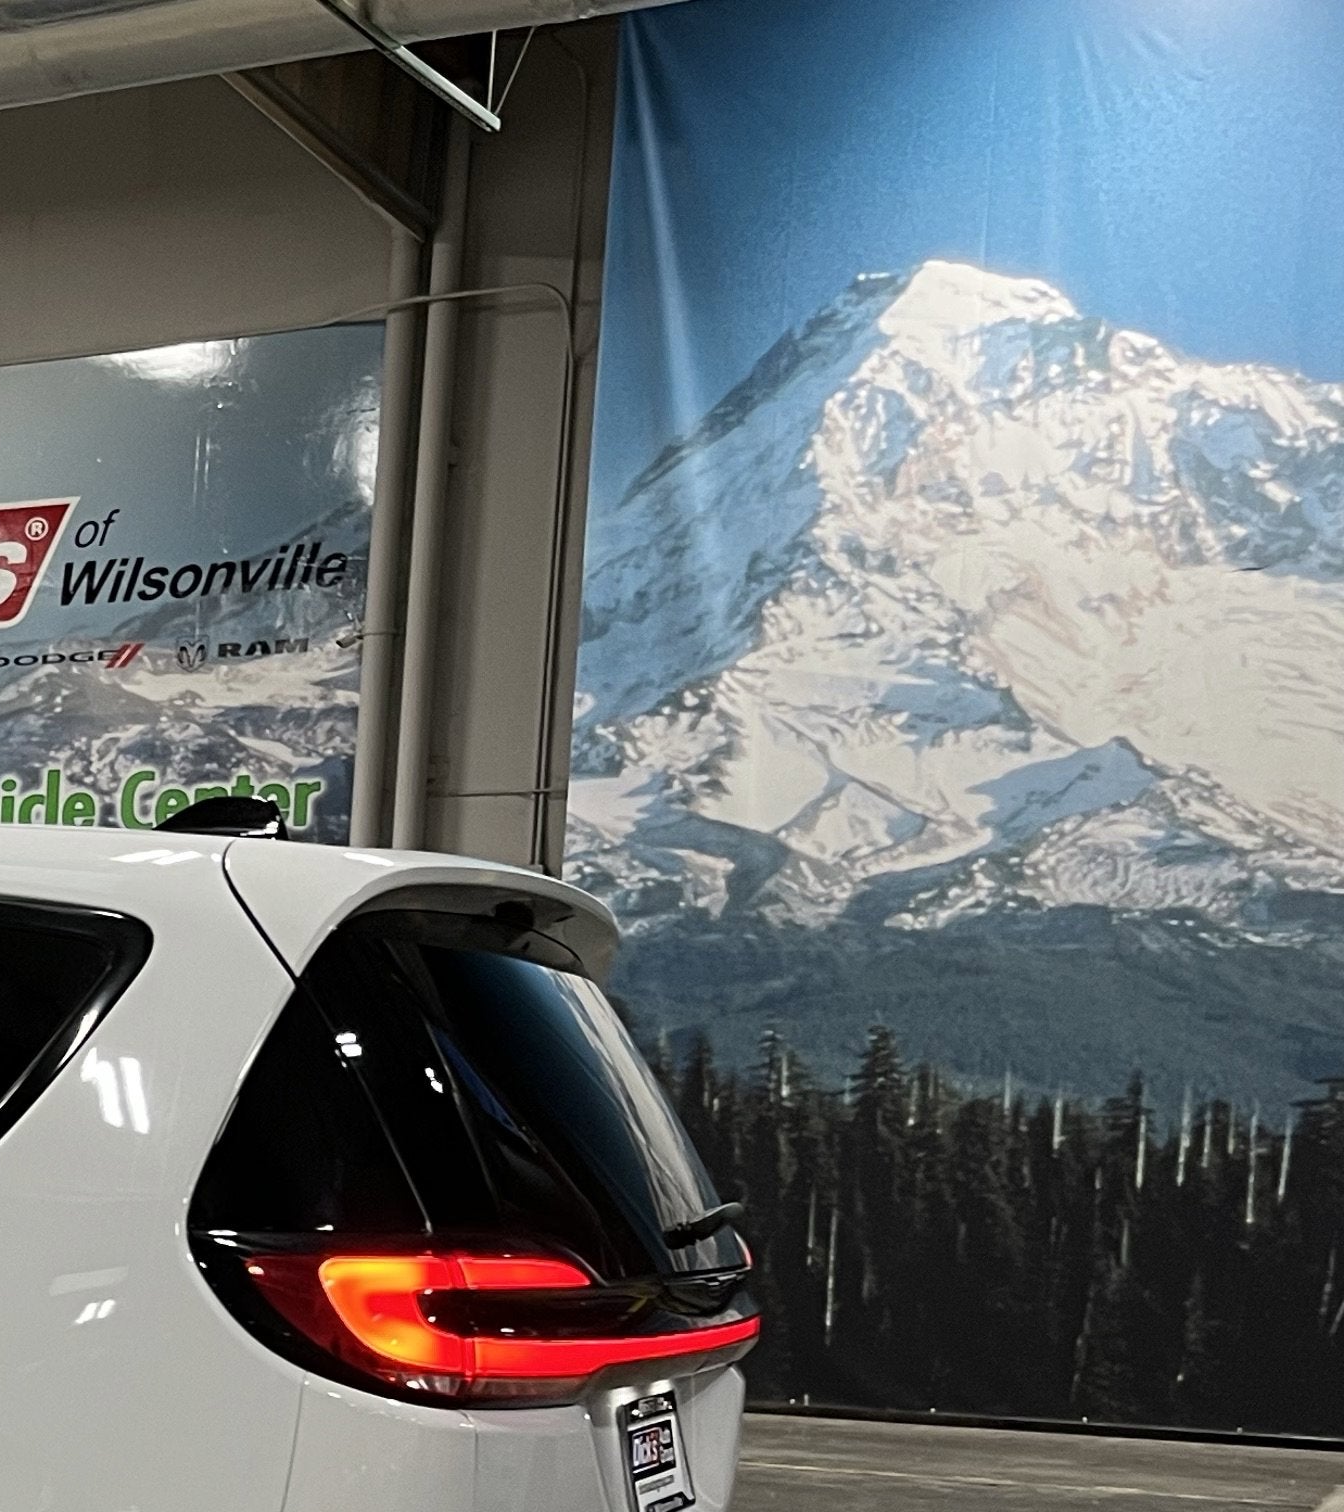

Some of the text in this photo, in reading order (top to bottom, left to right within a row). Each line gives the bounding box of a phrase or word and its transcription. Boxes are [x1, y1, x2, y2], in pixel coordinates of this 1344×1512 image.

[75, 509, 120, 548] of
[60, 542, 348, 606] Wilsonville
[217, 638, 309, 658] RAM
